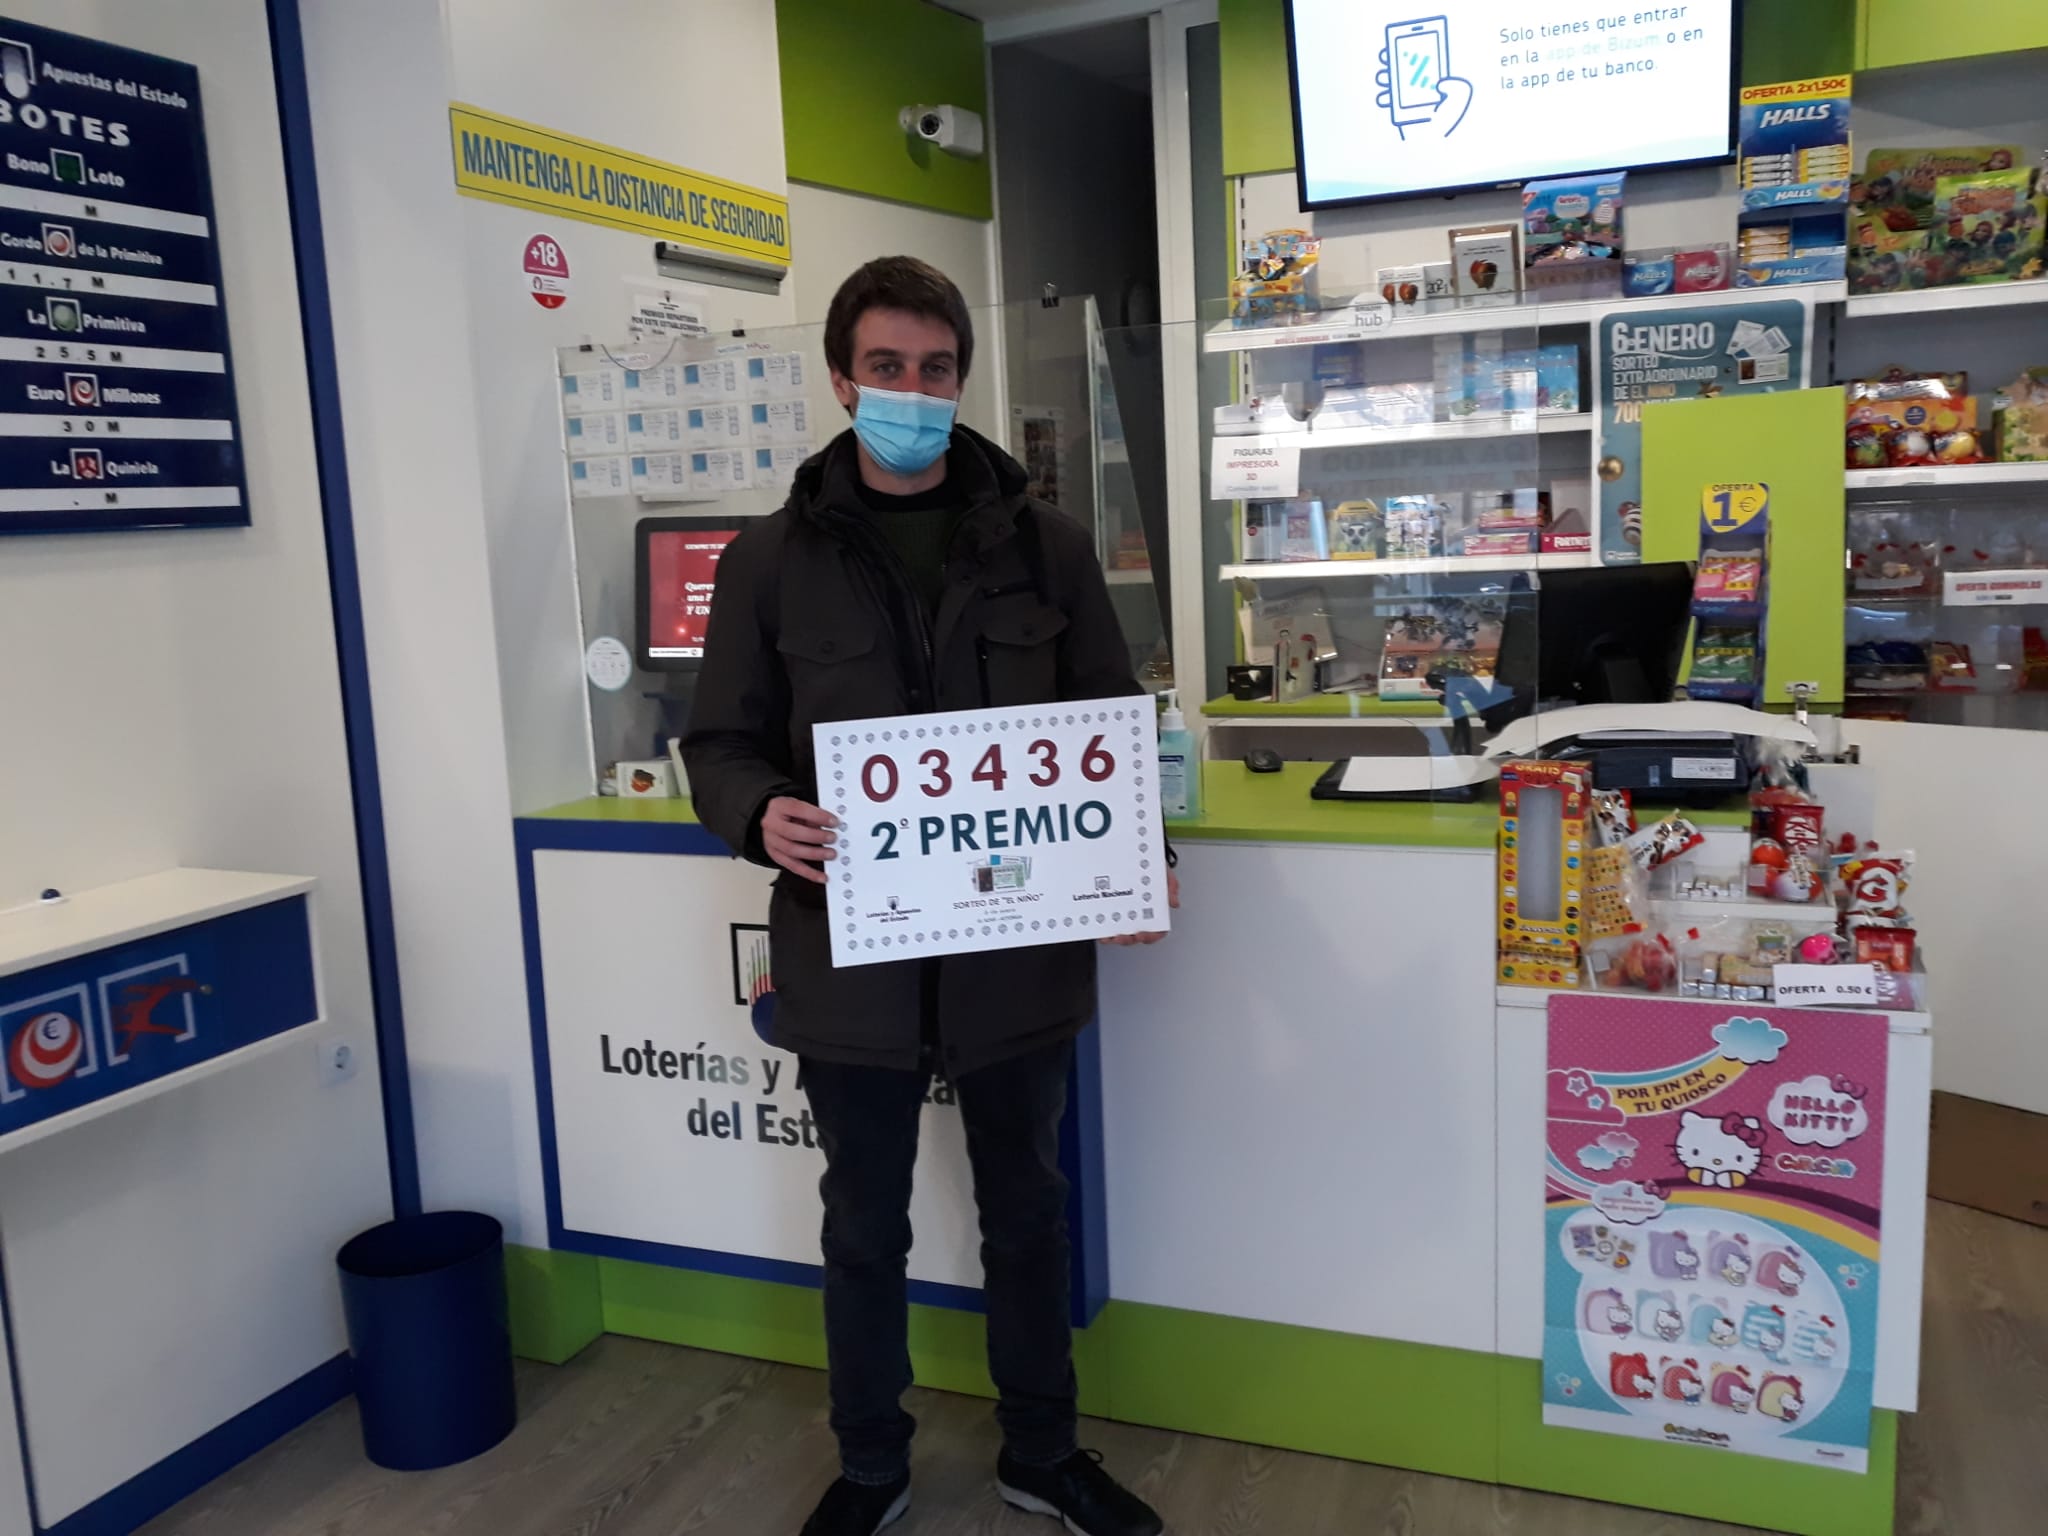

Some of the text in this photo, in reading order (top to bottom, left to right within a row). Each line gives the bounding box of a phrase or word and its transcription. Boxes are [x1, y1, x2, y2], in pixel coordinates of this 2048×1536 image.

[1500, 6, 1688, 43] Solo tienes que entrar
[1501, 53, 1519, 67] en
[1526, 50, 1539, 63] la
[1607, 33, 1660, 52] Bizum
[1667, 31, 1676, 44] o
[1683, 27, 1704, 42] en
[42, 62, 188, 109] Apuestas del Estado
[1501, 58, 1658, 90] la app de tu banco.
[1743, 84, 1794, 100] OFERTA
[0, 99, 131, 147] BOTES
[1759, 103, 1831, 129] HALLS
[7, 153, 126, 188] Bono Loto
[461, 130, 786, 248] MANTENGA LA DISTANCIA DE SEGURIDAD
[1775, 188, 1813, 201] HALLS
[85, 205, 98, 217] M
[1, 232, 164, 265] Gordo de la Primitiva
[530, 240, 559, 268] +18
[1773, 266, 1809, 279] HALLS
[27, 309, 147, 333] La Primitiva
[1355, 313, 1383, 327] hub
[1634, 321, 1715, 352] ENERO
[1613, 355, 1659, 371] SORTEO
[1613, 365, 1718, 386] EXTRAORDINARIO
[26, 384, 162, 405] Euro Millones
[1614, 386, 1629, 400] DE
[1614, 401, 1642, 424] 700
[1233, 447, 1273, 457] FIGURAS
[51, 460, 159, 476] La Quiniela
[1226, 459, 1280, 469] IMPRESORA
[1712, 482, 1755, 493] OFERTA
[861, 734, 1116, 804] 03436
[871, 800, 1112, 861] 2º PREMIO
[952, 899, 987, 910] SORTEO
[988, 897, 1001, 907] DE
[1778, 985, 1873, 996] OFERTA 0.50 €
[600, 1033, 750, 1086] Loterías
[762, 1058, 781, 1096] y
[1617, 1068, 1707, 1099] POR FIN EN
[1634, 1073, 1727, 1113] TU QUIOSCO
[1784, 1094, 1857, 1115] HELLO
[687, 1097, 742, 1140] del
[1784, 1112, 1854, 1133] KITTY
